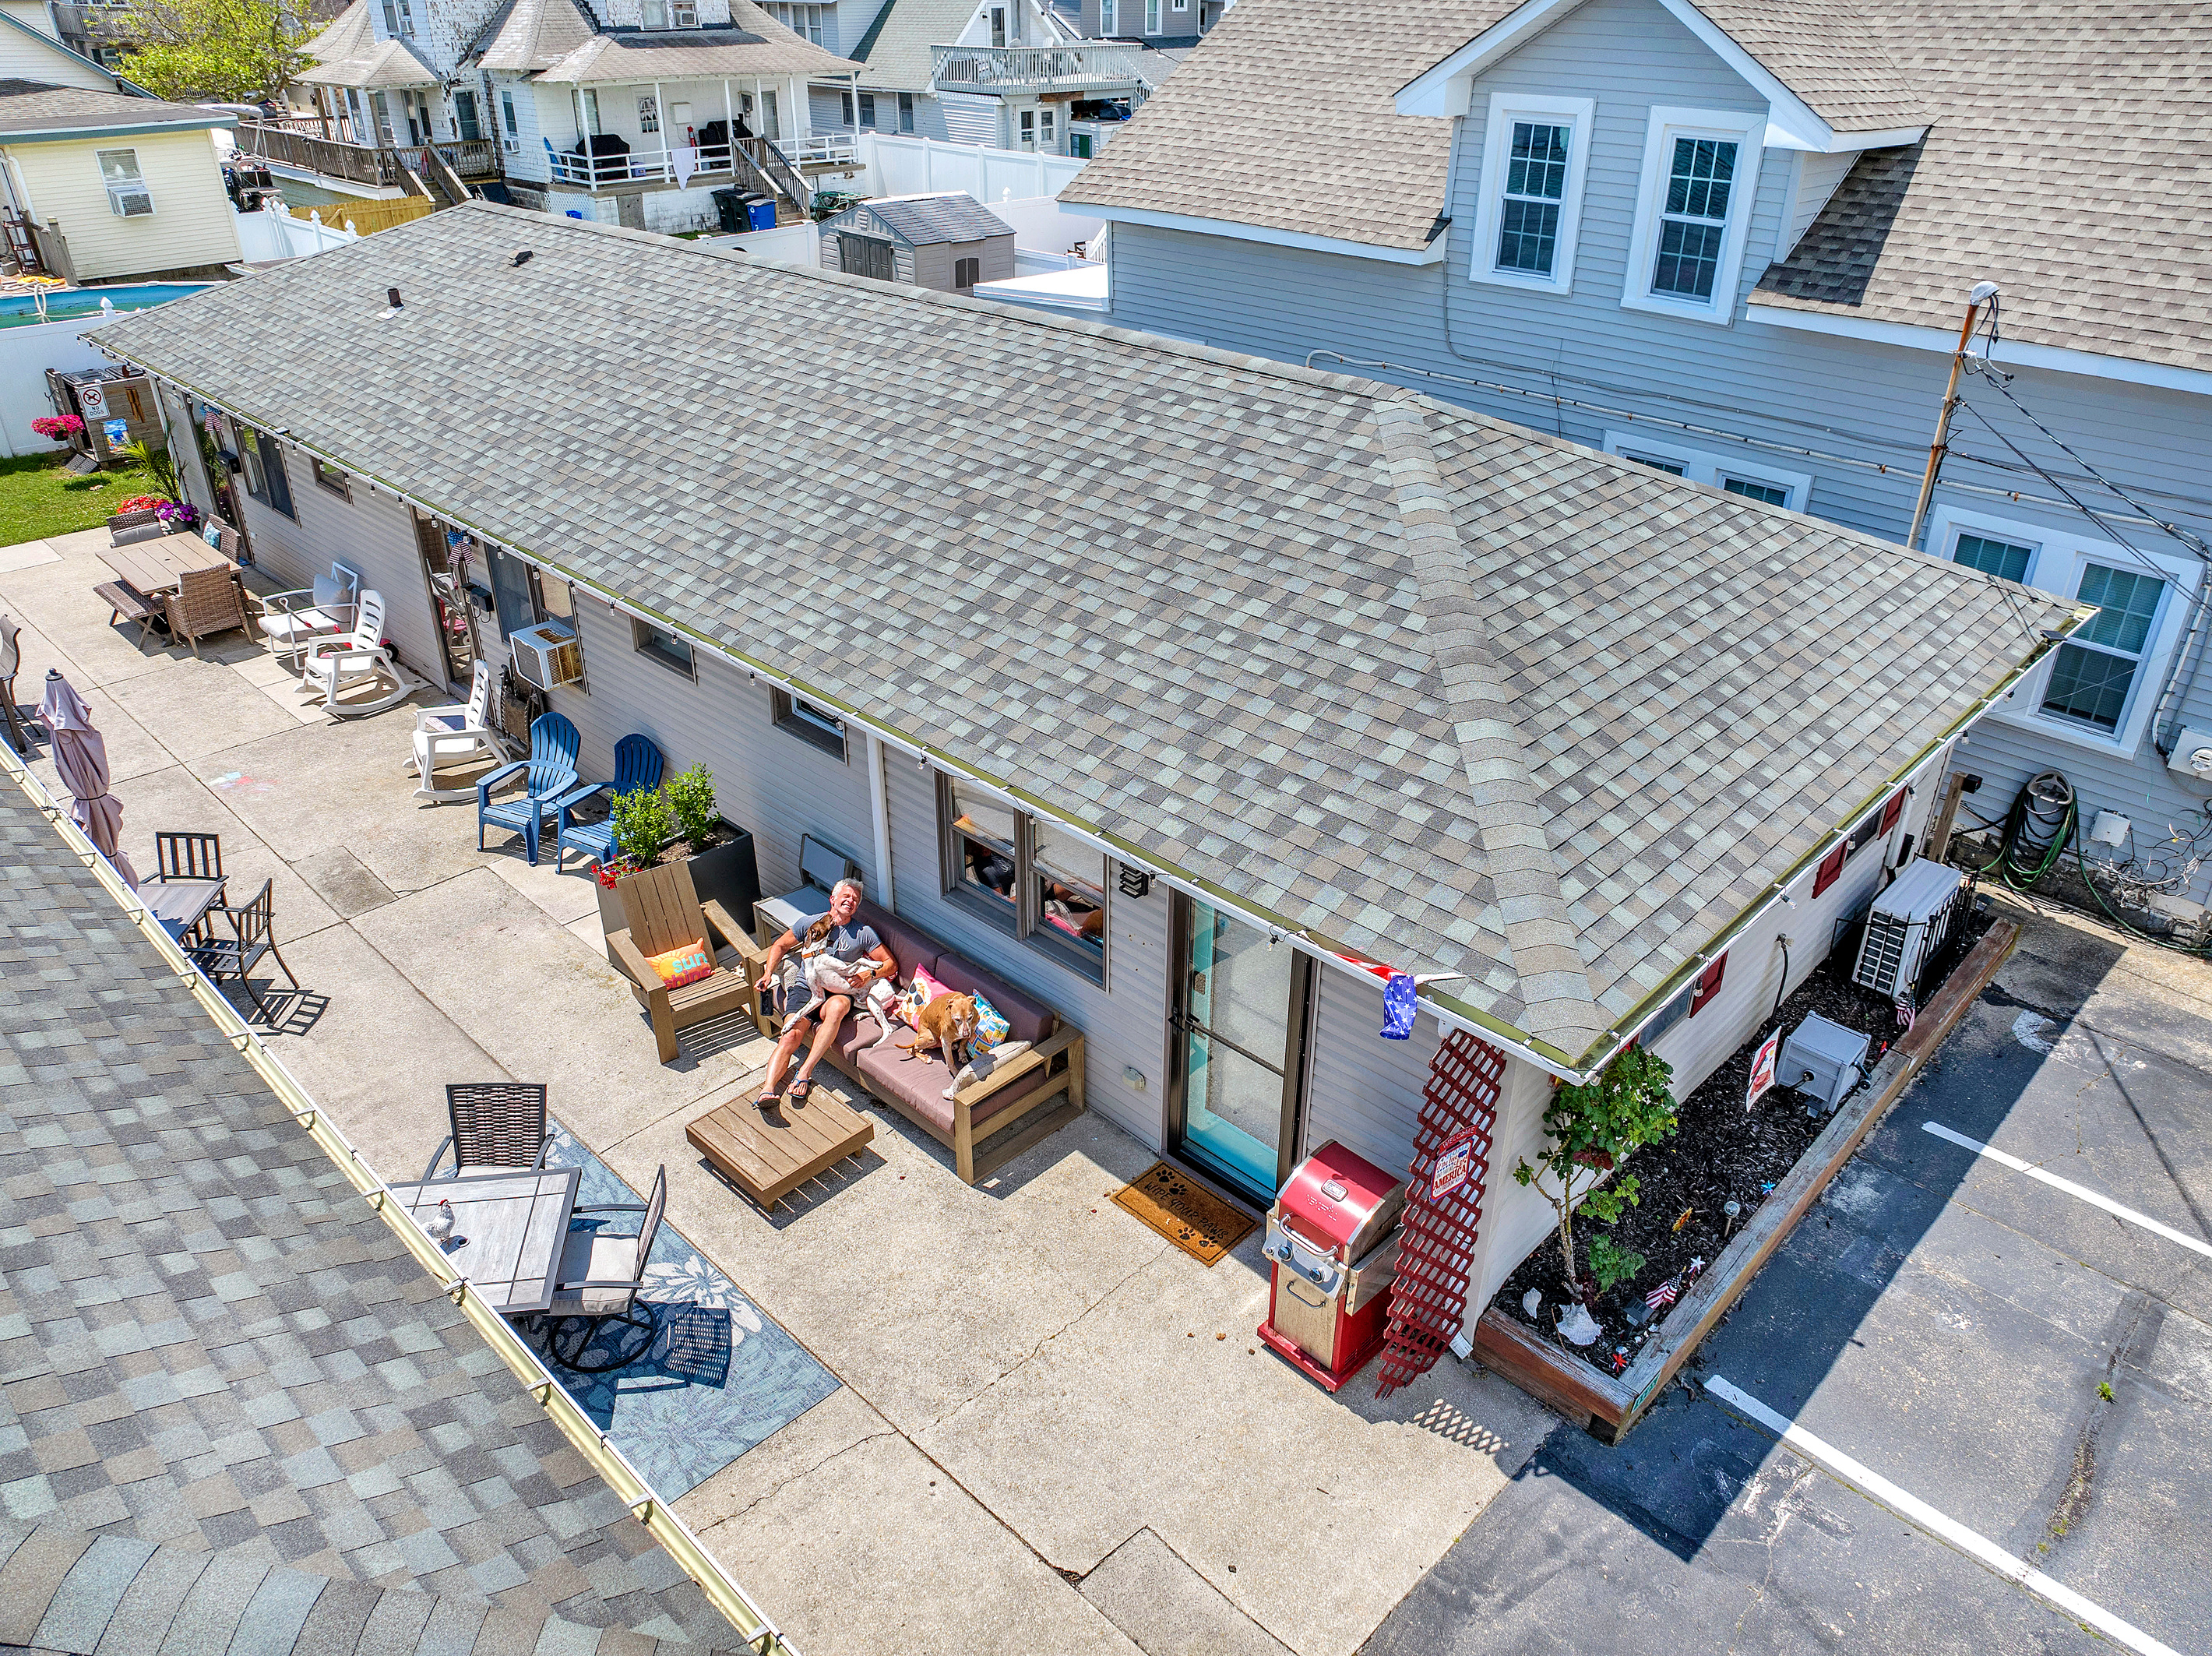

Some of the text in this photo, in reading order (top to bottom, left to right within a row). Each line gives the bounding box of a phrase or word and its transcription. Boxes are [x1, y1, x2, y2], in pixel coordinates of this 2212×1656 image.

[672, 953, 708, 974] sun
[664, 967, 712, 990] shine
[1442, 1126, 1475, 1149] WELCOME
[1433, 1164, 1467, 1190] AMERICA
[1143, 1181, 1229, 1240] WIPE YOUR PAWS
